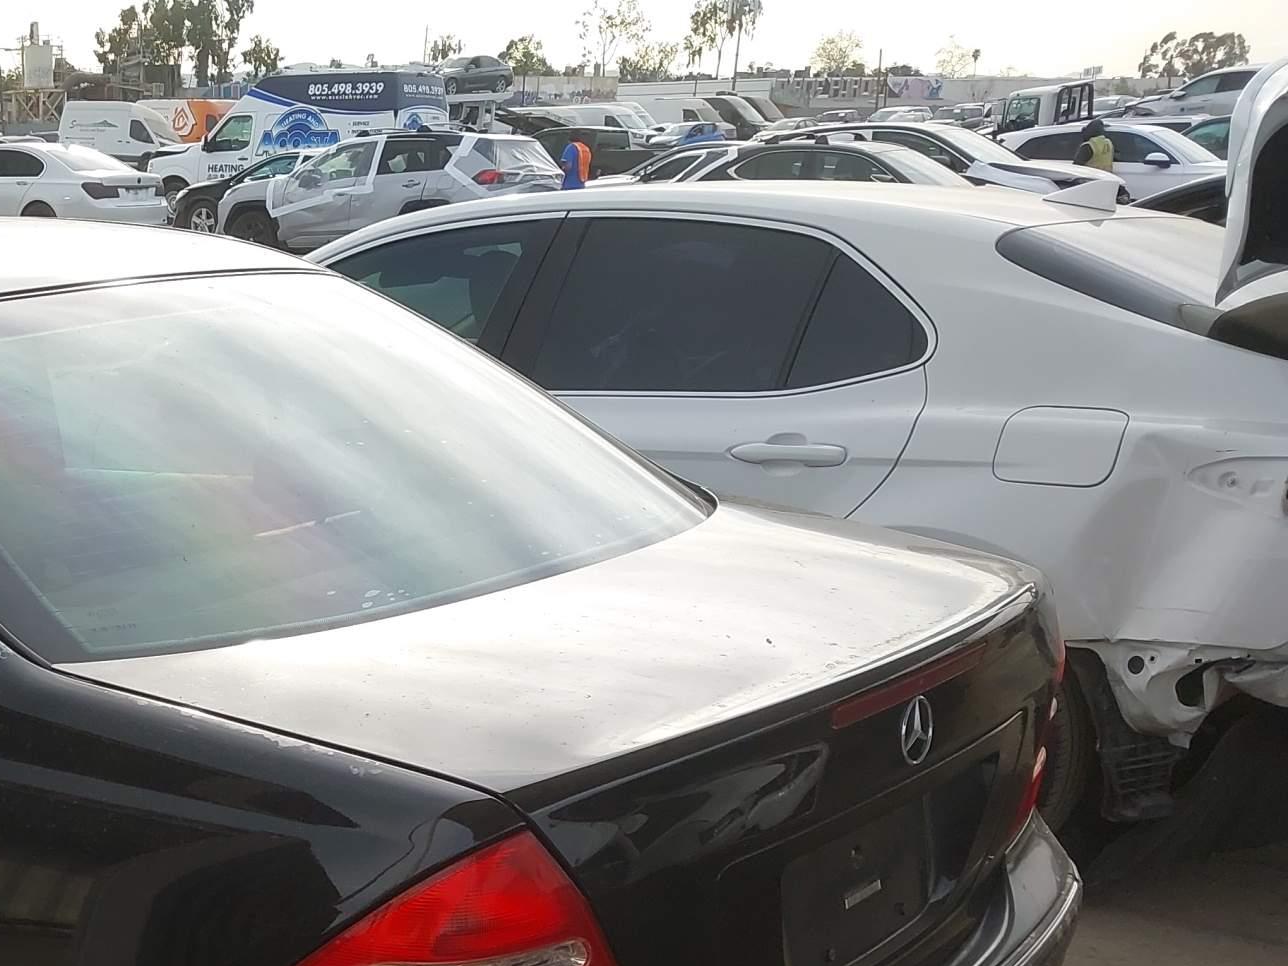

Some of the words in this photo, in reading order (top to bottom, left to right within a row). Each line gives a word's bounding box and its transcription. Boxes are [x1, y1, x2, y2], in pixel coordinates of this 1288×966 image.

[308, 82, 385, 95] 805.498.3939
[281, 113, 307, 128] HEATING
[207, 163, 244, 173] HEATING
